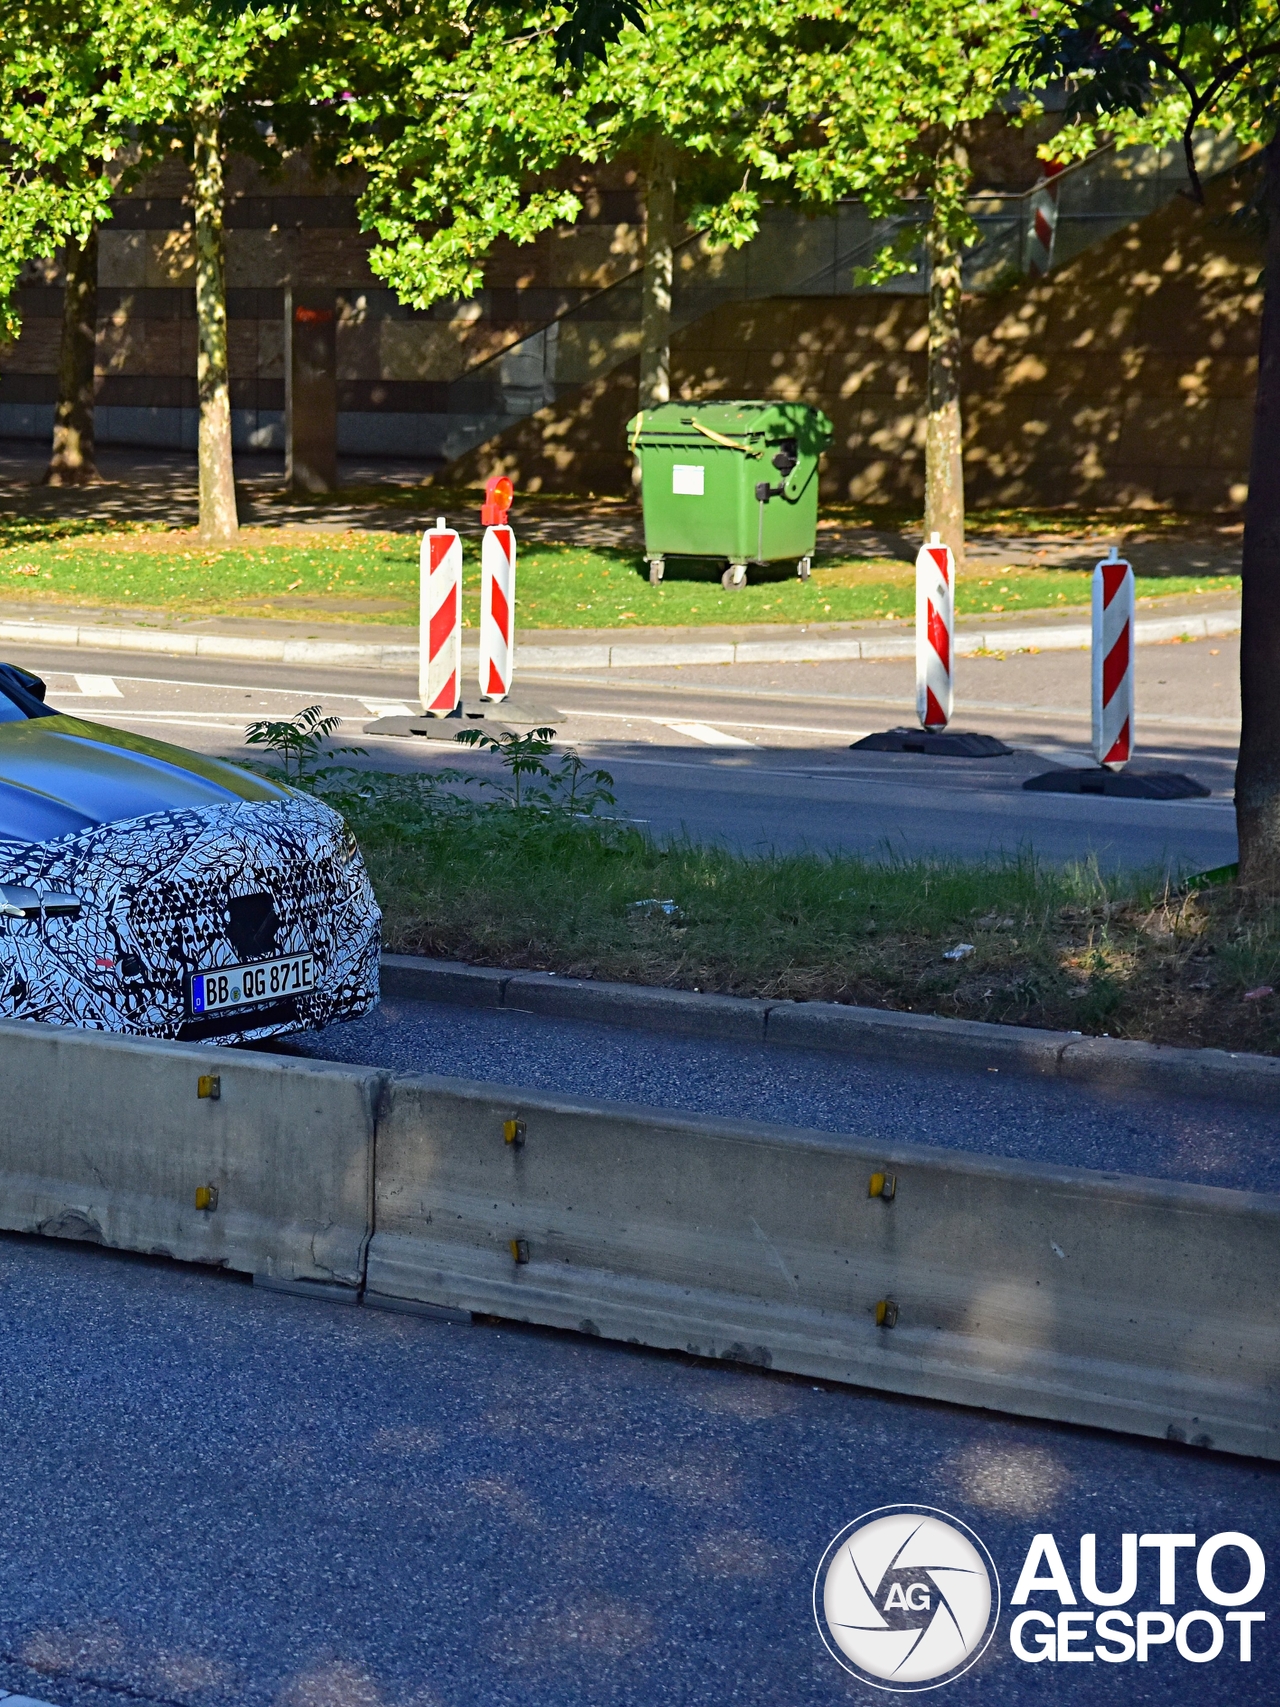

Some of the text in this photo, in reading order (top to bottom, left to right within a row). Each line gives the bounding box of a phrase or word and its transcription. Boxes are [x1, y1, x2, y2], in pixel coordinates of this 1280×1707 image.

[206, 958, 312, 1006] BB QG 871E
